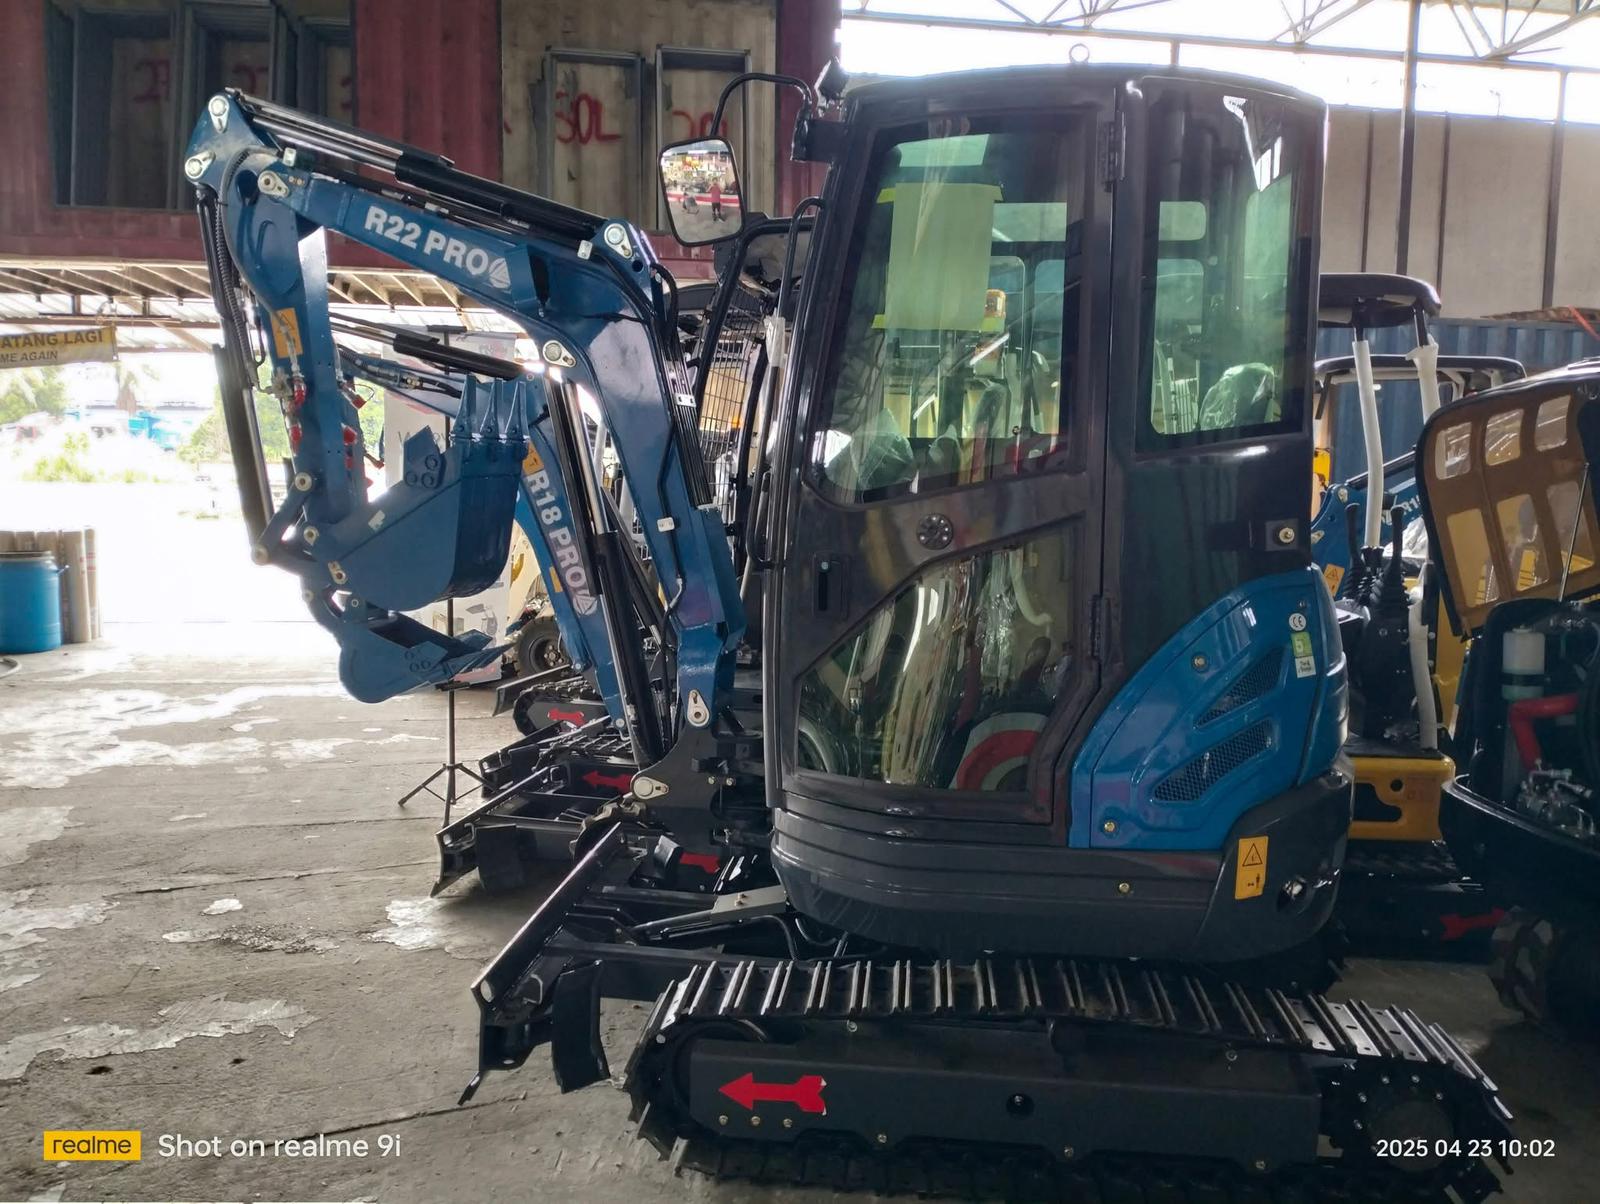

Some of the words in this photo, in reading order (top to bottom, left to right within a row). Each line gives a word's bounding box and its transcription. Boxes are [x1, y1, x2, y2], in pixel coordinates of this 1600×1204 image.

[364, 205, 421, 249] R22
[423, 229, 489, 276] PRO
[1, 333, 58, 349] ATANG
[64, 329, 103, 345] LAGI
[20, 351, 58, 362] AGAIN
[527, 470, 562, 525] R18
[549, 526, 587, 588] PRO
